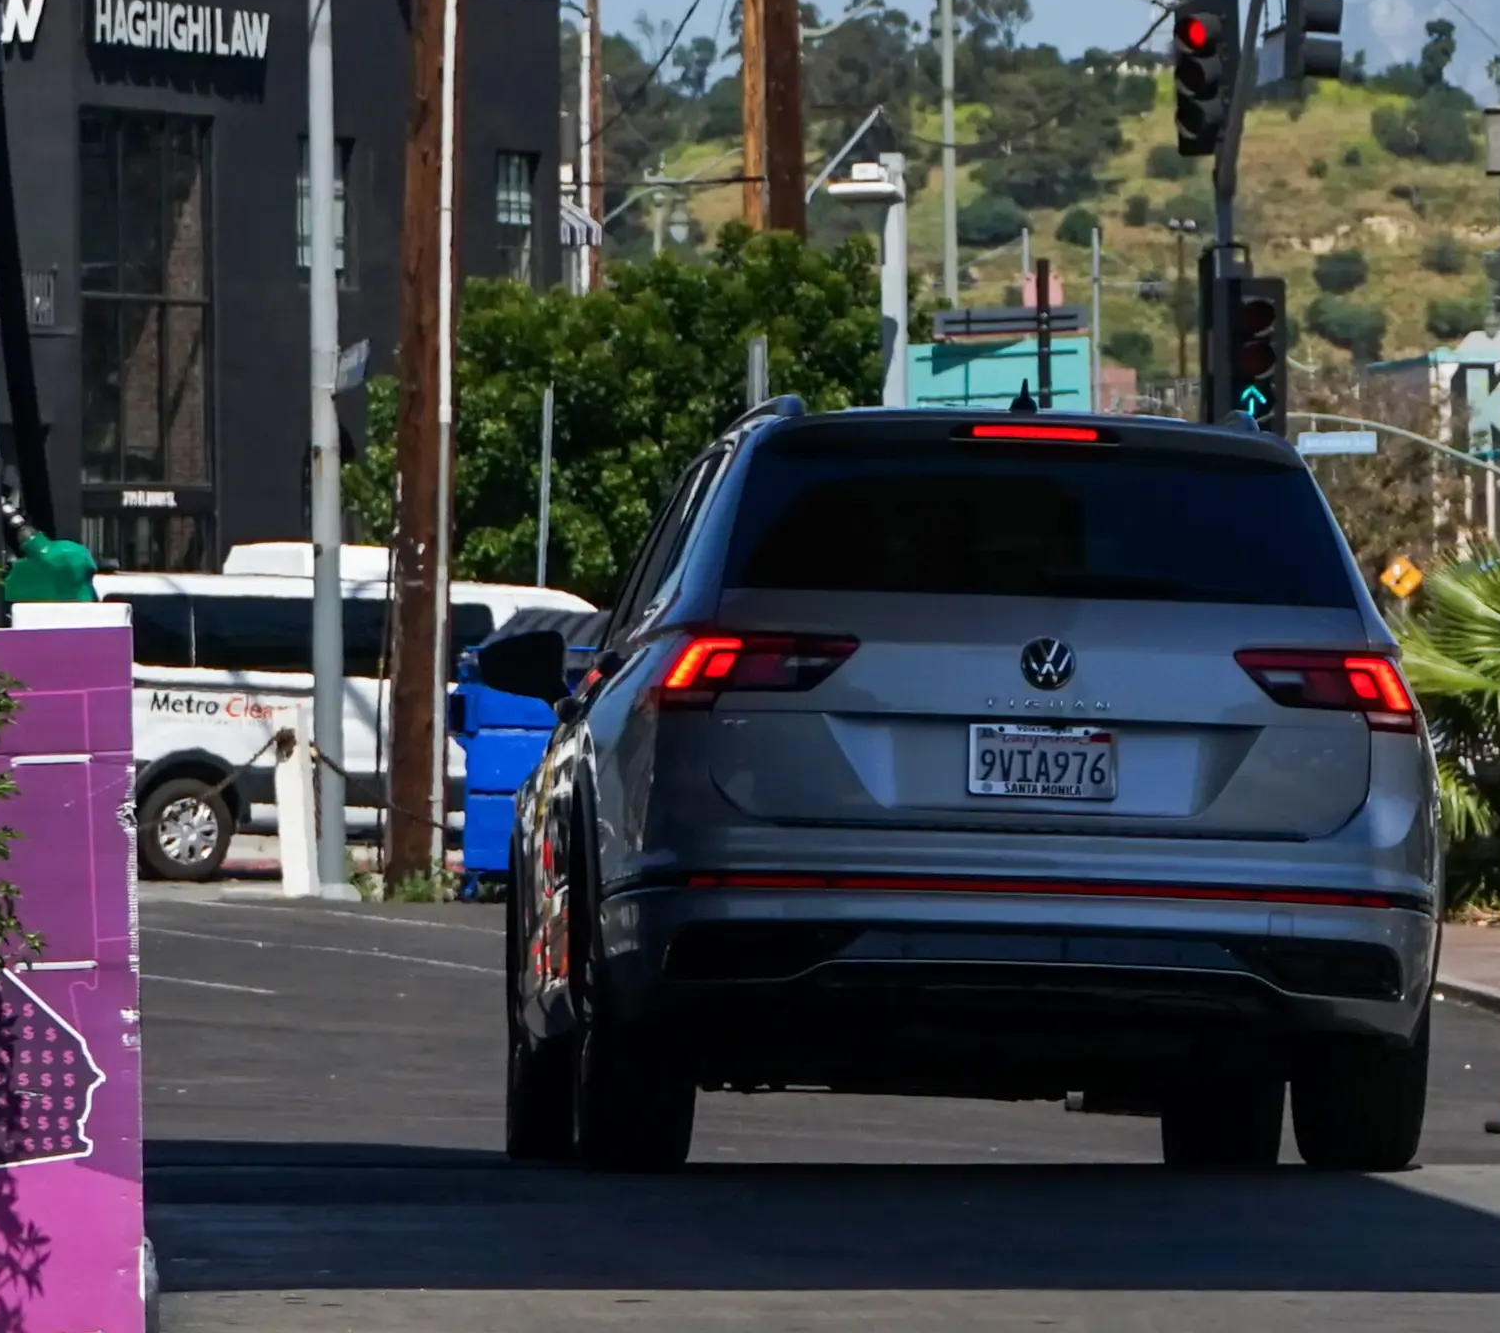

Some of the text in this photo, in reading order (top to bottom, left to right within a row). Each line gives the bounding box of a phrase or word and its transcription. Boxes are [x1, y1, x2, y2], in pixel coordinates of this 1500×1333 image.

[215, 8, 270, 59] LAW
[150, 691, 220, 715] Metro
[980, 749, 1106, 785] 9VIA976
[1004, 783, 1082, 796] SANTA MONICA
